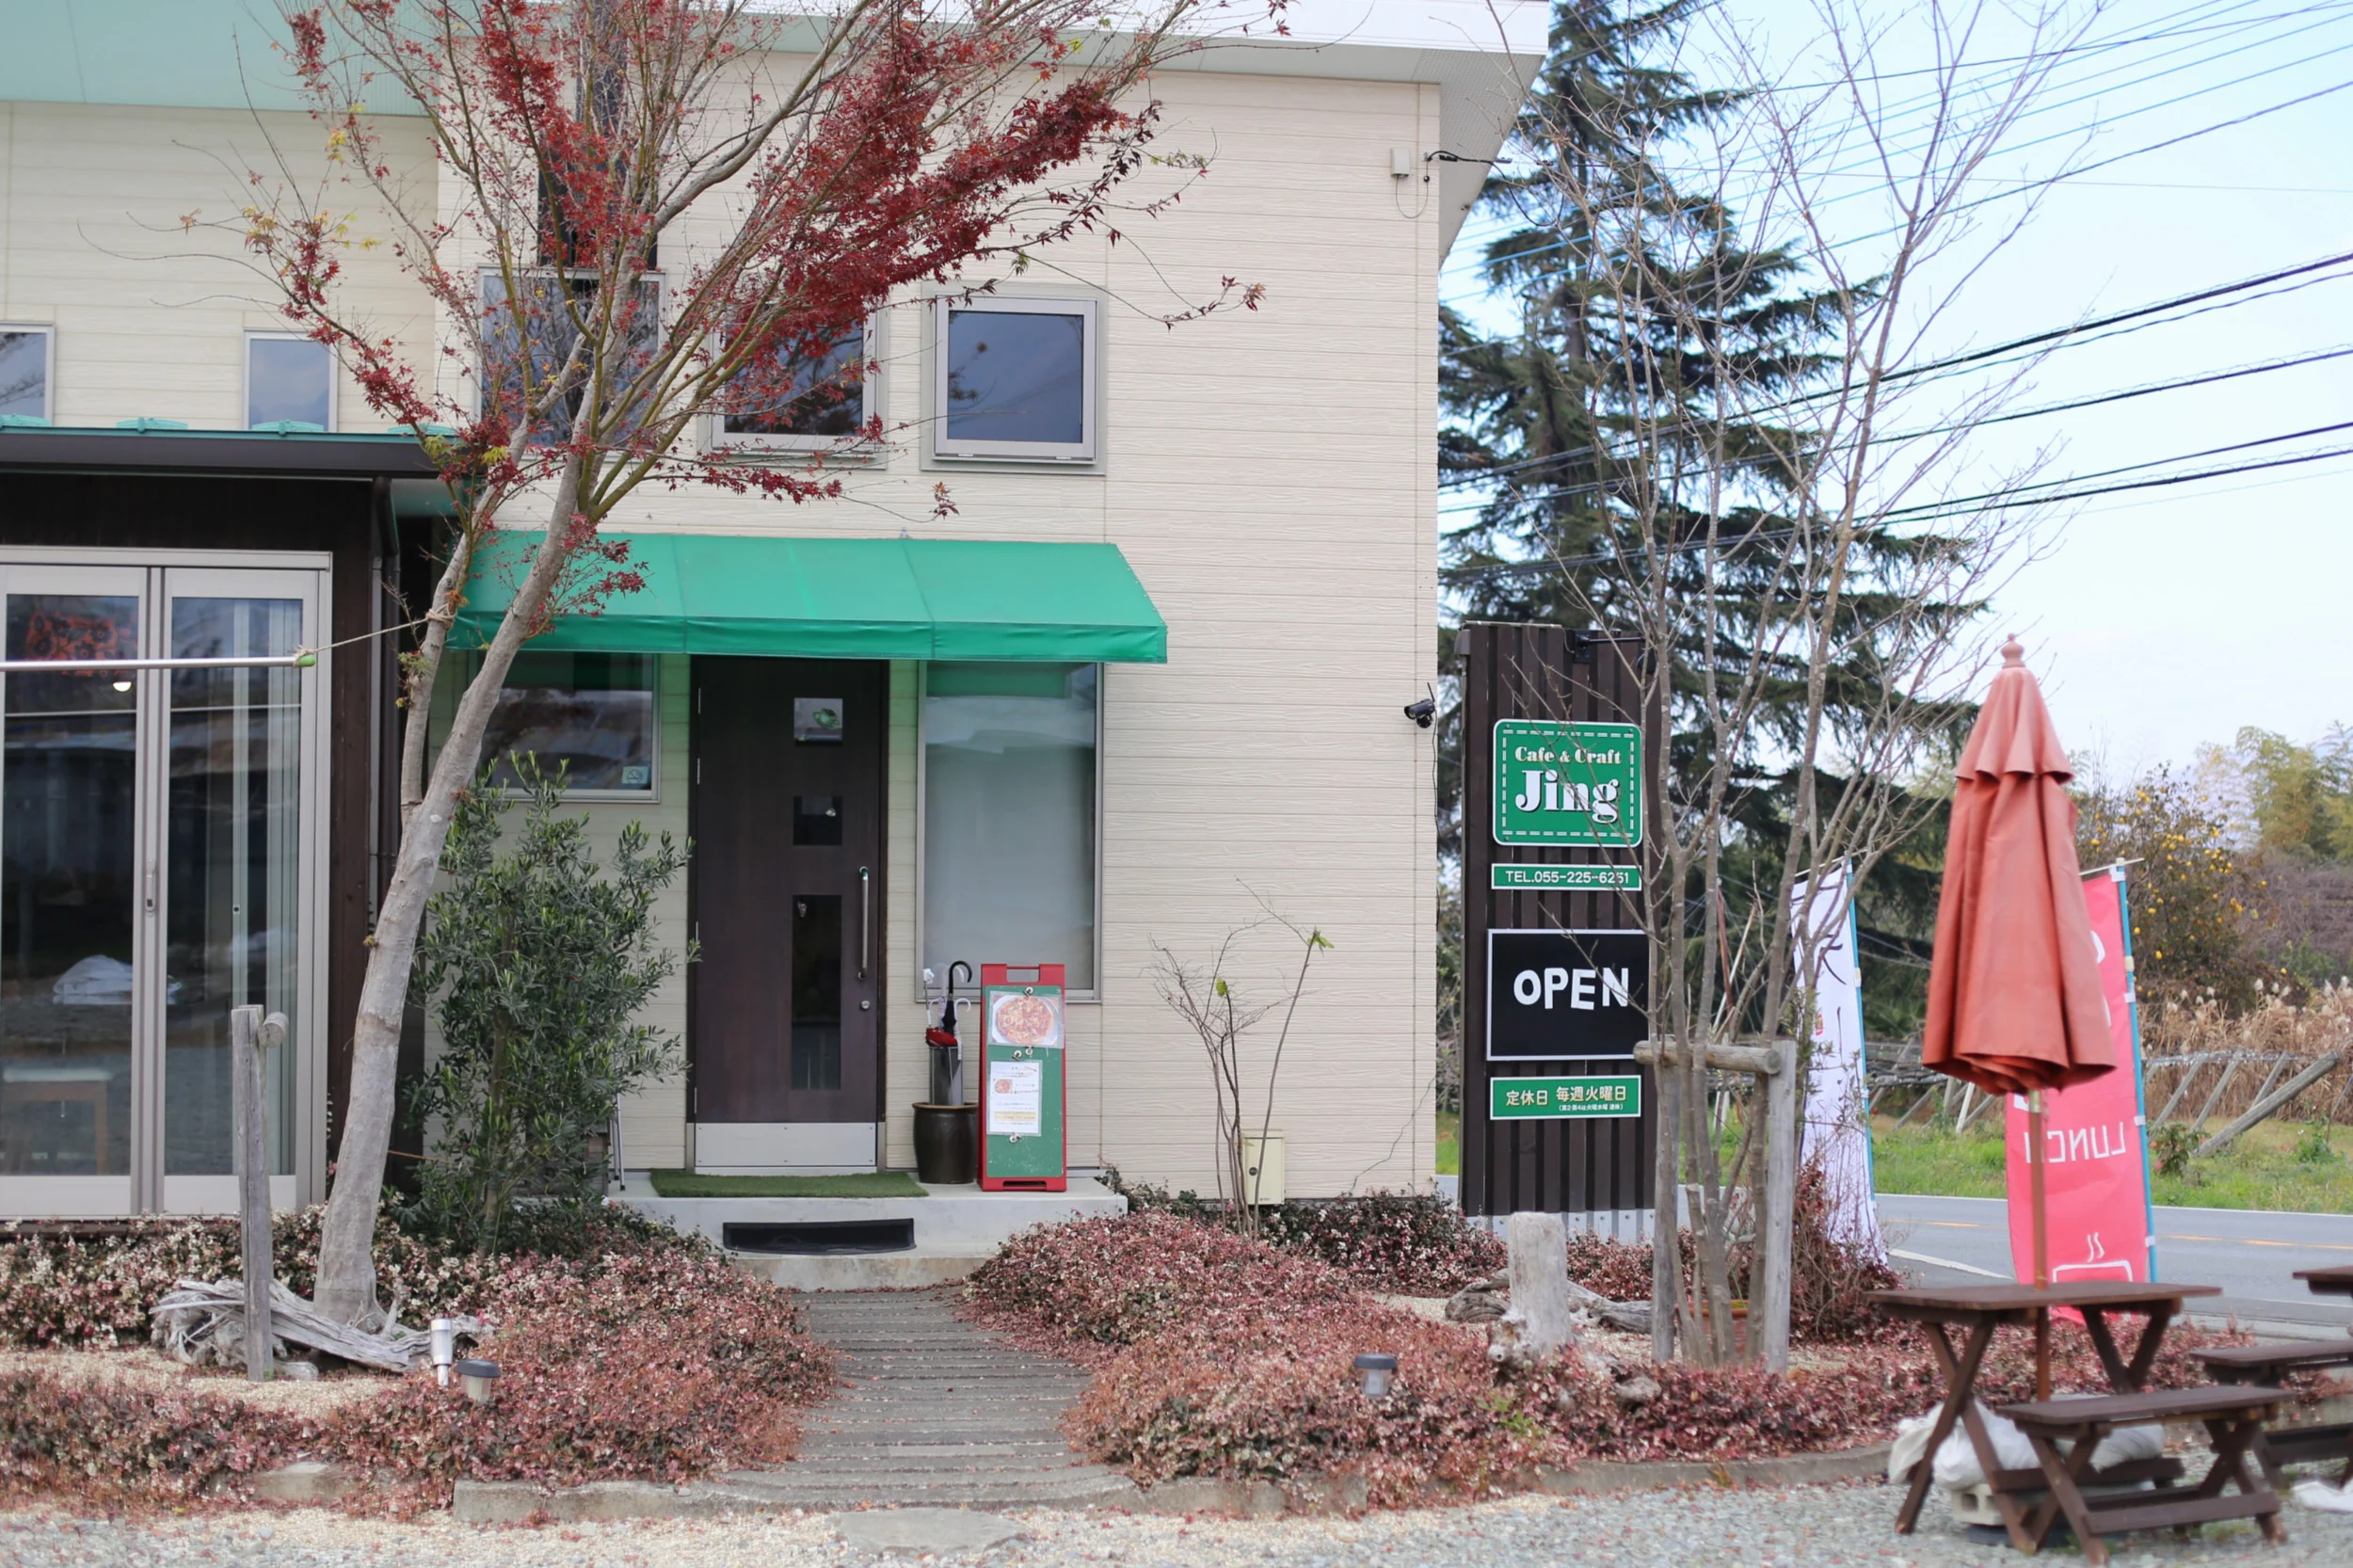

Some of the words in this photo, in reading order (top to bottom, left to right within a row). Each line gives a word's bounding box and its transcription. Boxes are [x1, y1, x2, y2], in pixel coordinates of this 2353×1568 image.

[1515, 746, 1555, 762] Cafe
[1560, 751, 1571, 763] &
[1575, 748, 1622, 764] Craft
[1515, 769, 1619, 824] Jing
[1513, 968, 1629, 1010] OPEN
[1506, 1090, 1548, 1106] 定休日
[1556, 1085, 1626, 1102] 毎週火曜日
